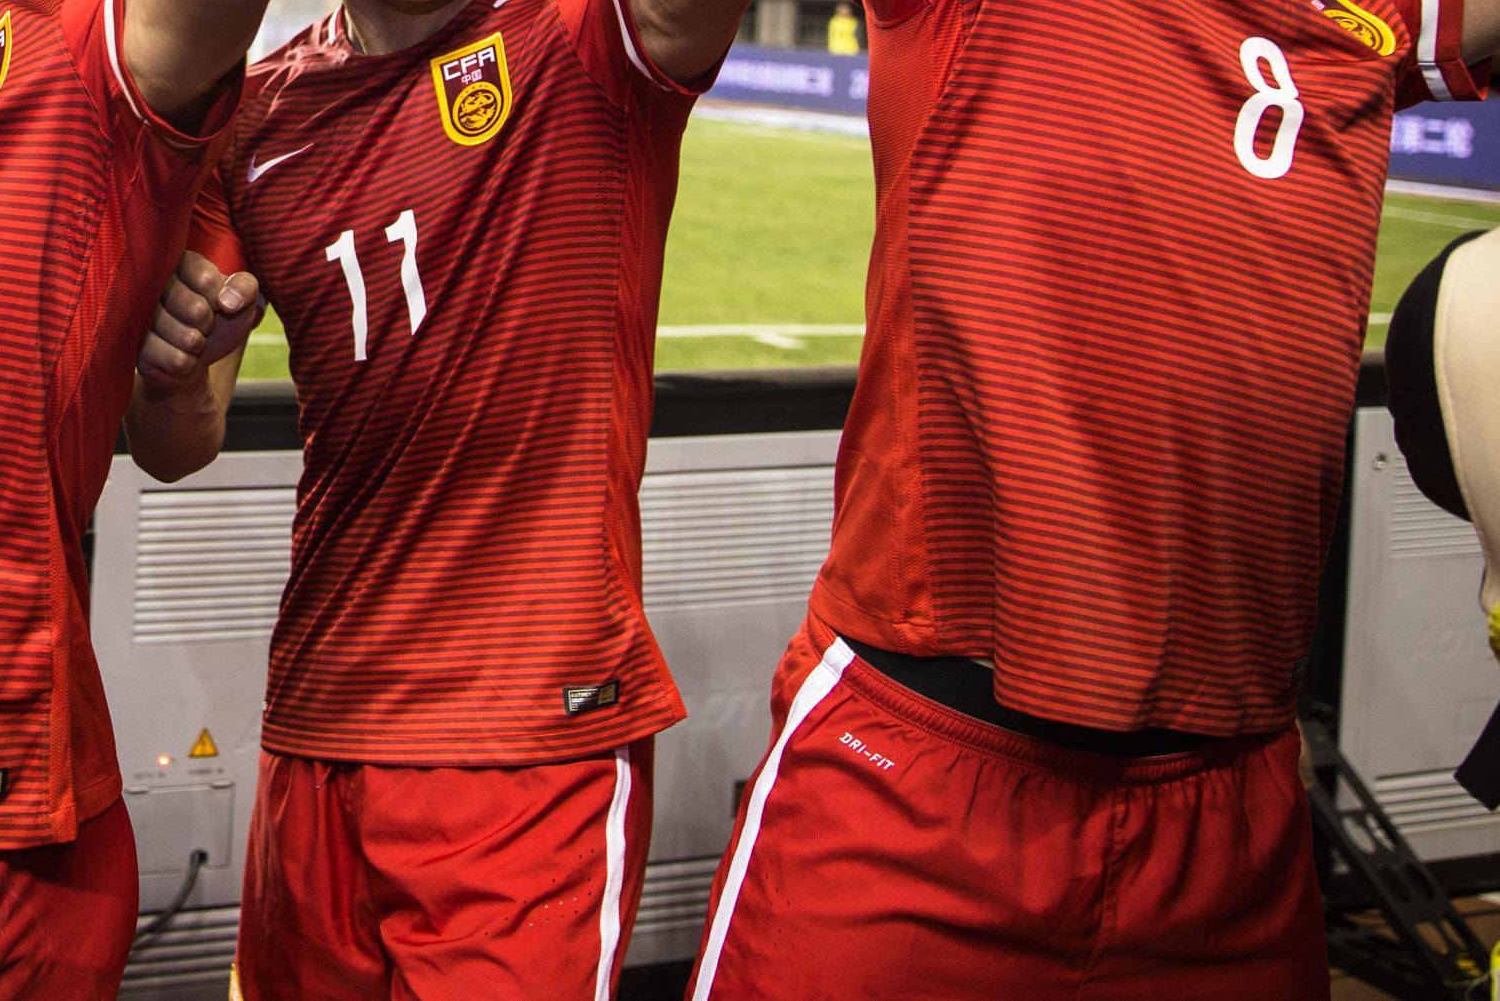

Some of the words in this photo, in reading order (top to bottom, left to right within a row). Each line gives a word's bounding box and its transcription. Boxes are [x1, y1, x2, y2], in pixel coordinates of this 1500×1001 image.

[443, 46, 496, 81] CFA
[461, 68, 483, 85] 中国
[1233, 36, 1304, 179] 8
[325, 209, 427, 362] 11
[839, 732, 895, 770] DRI-FIT
